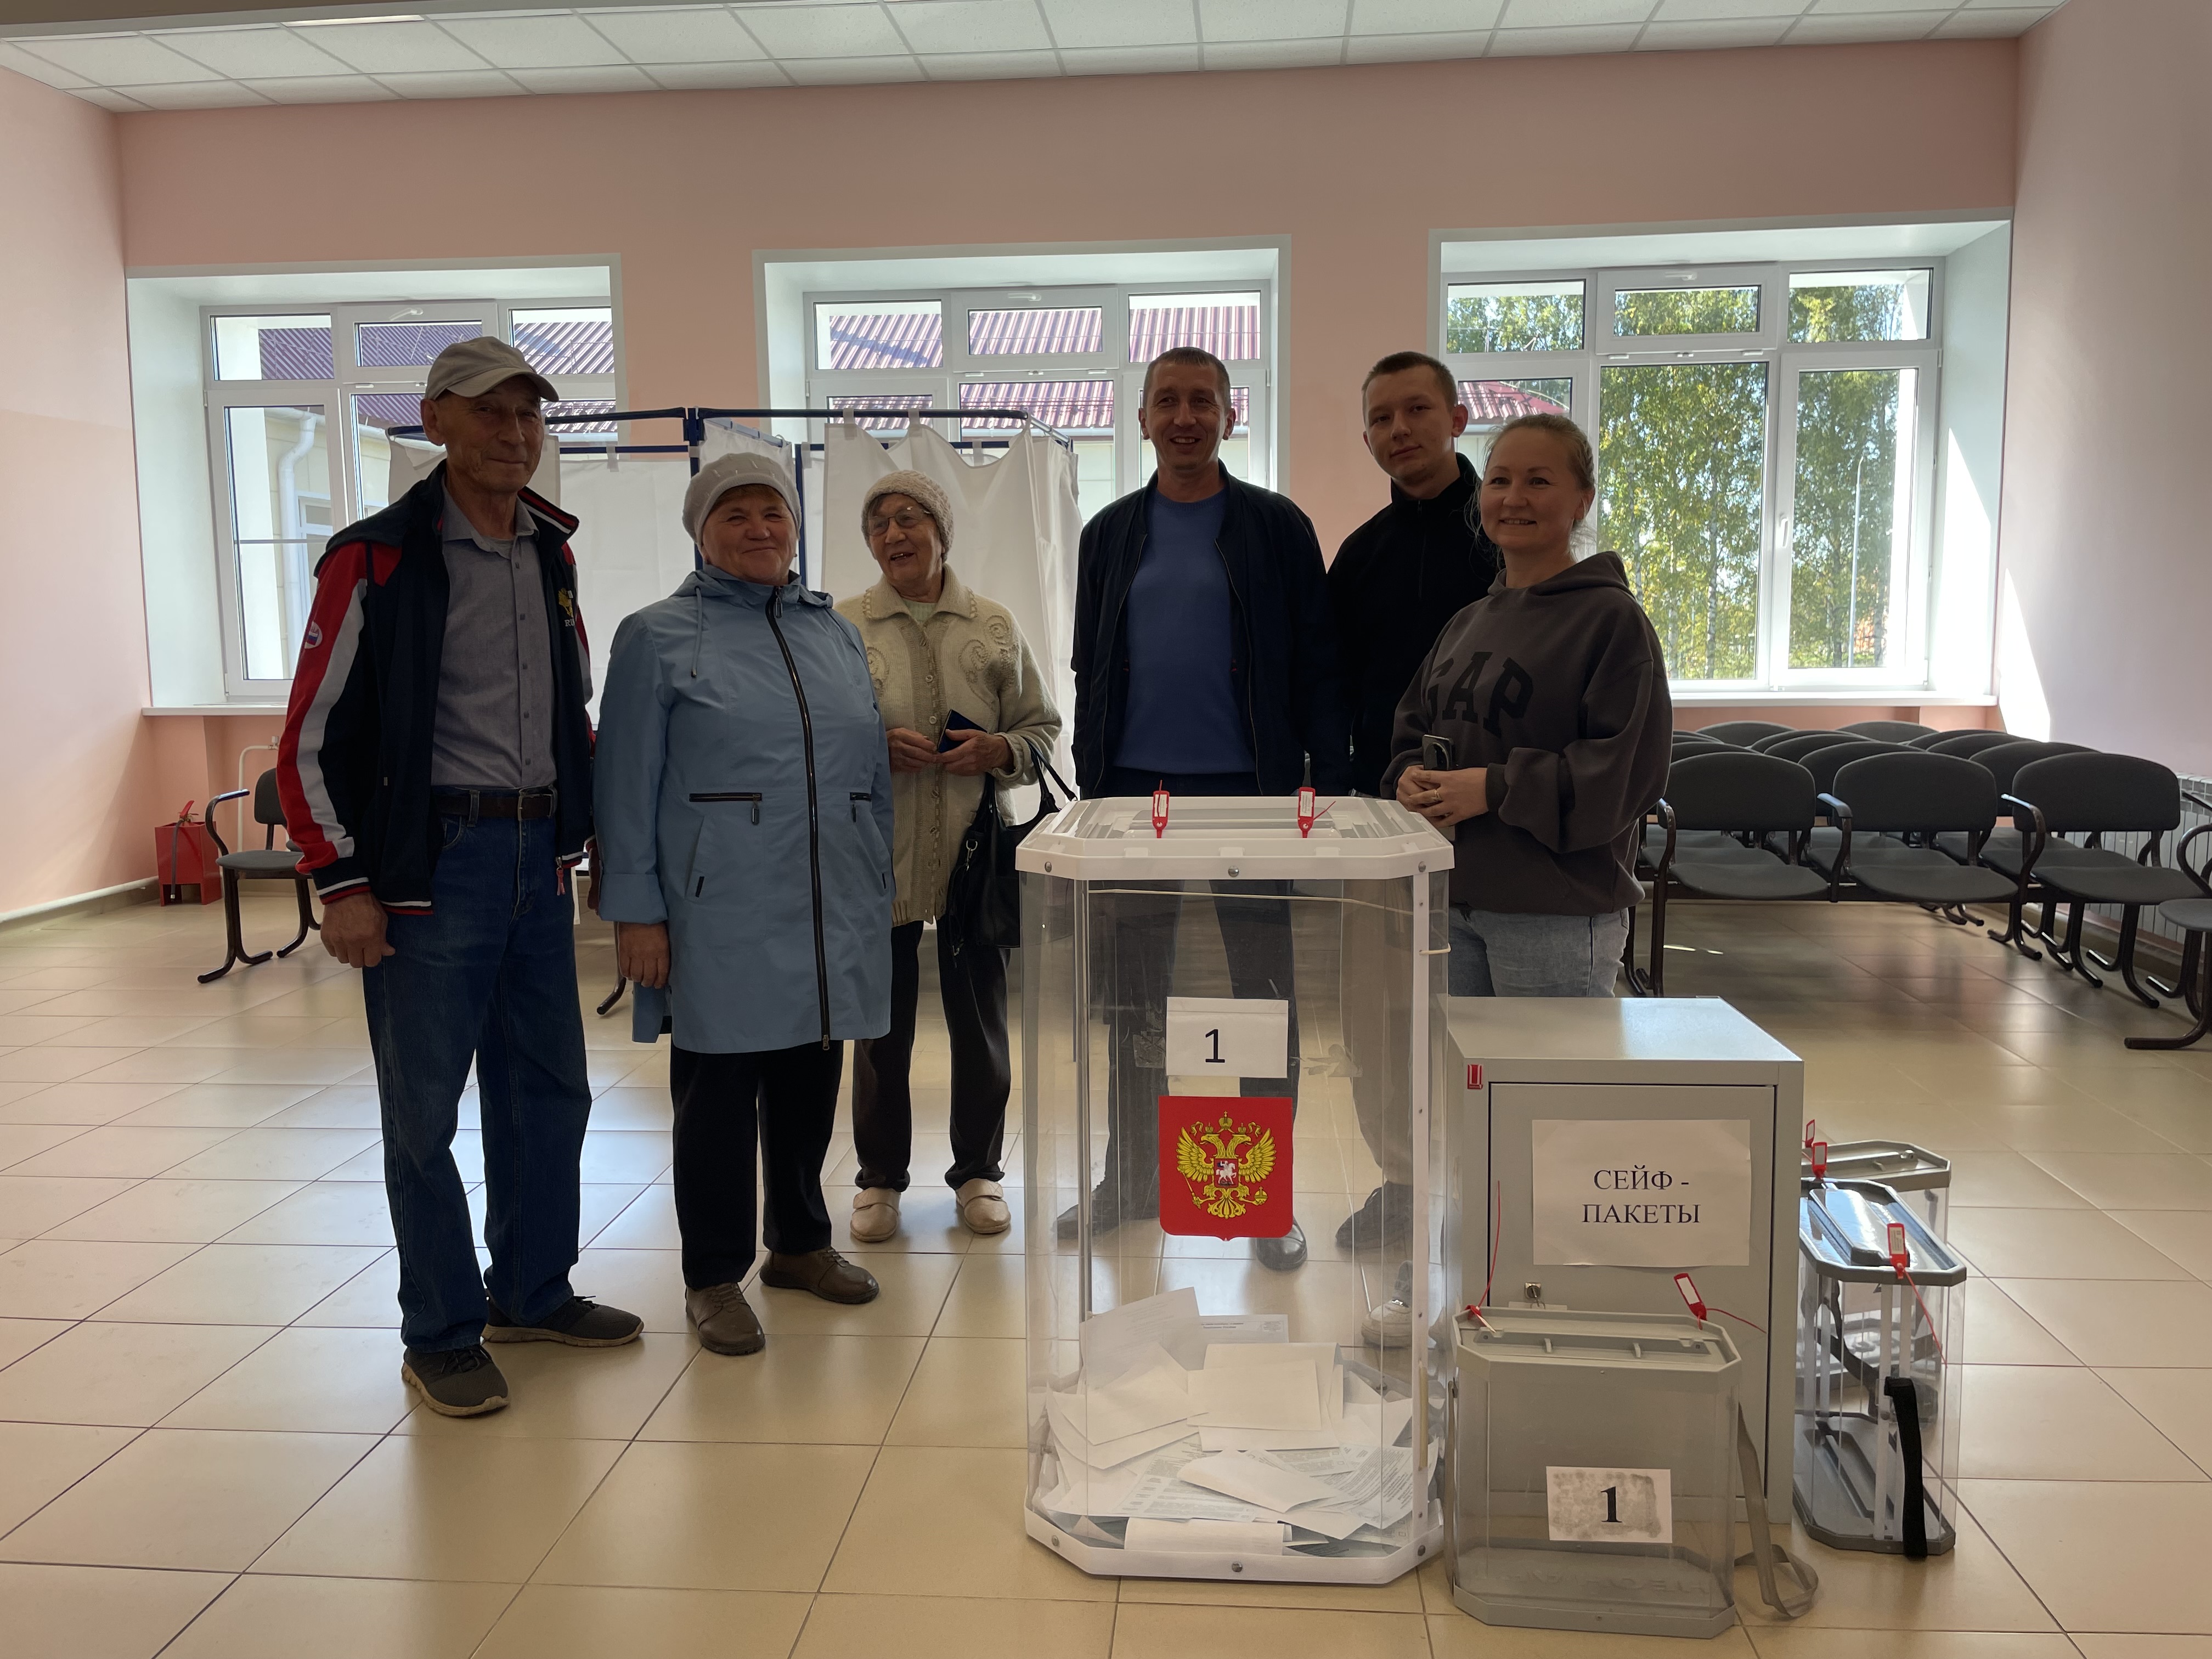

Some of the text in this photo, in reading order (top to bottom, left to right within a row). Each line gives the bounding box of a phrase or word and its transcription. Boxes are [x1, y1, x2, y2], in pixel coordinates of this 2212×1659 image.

[1205, 1029, 1226, 1063] 1
[1594, 1164, 1673, 1190] СЕЙФ
[1582, 1204, 1700, 1223] ПАКЕТЫ
[1601, 1486, 1622, 1523] 1
